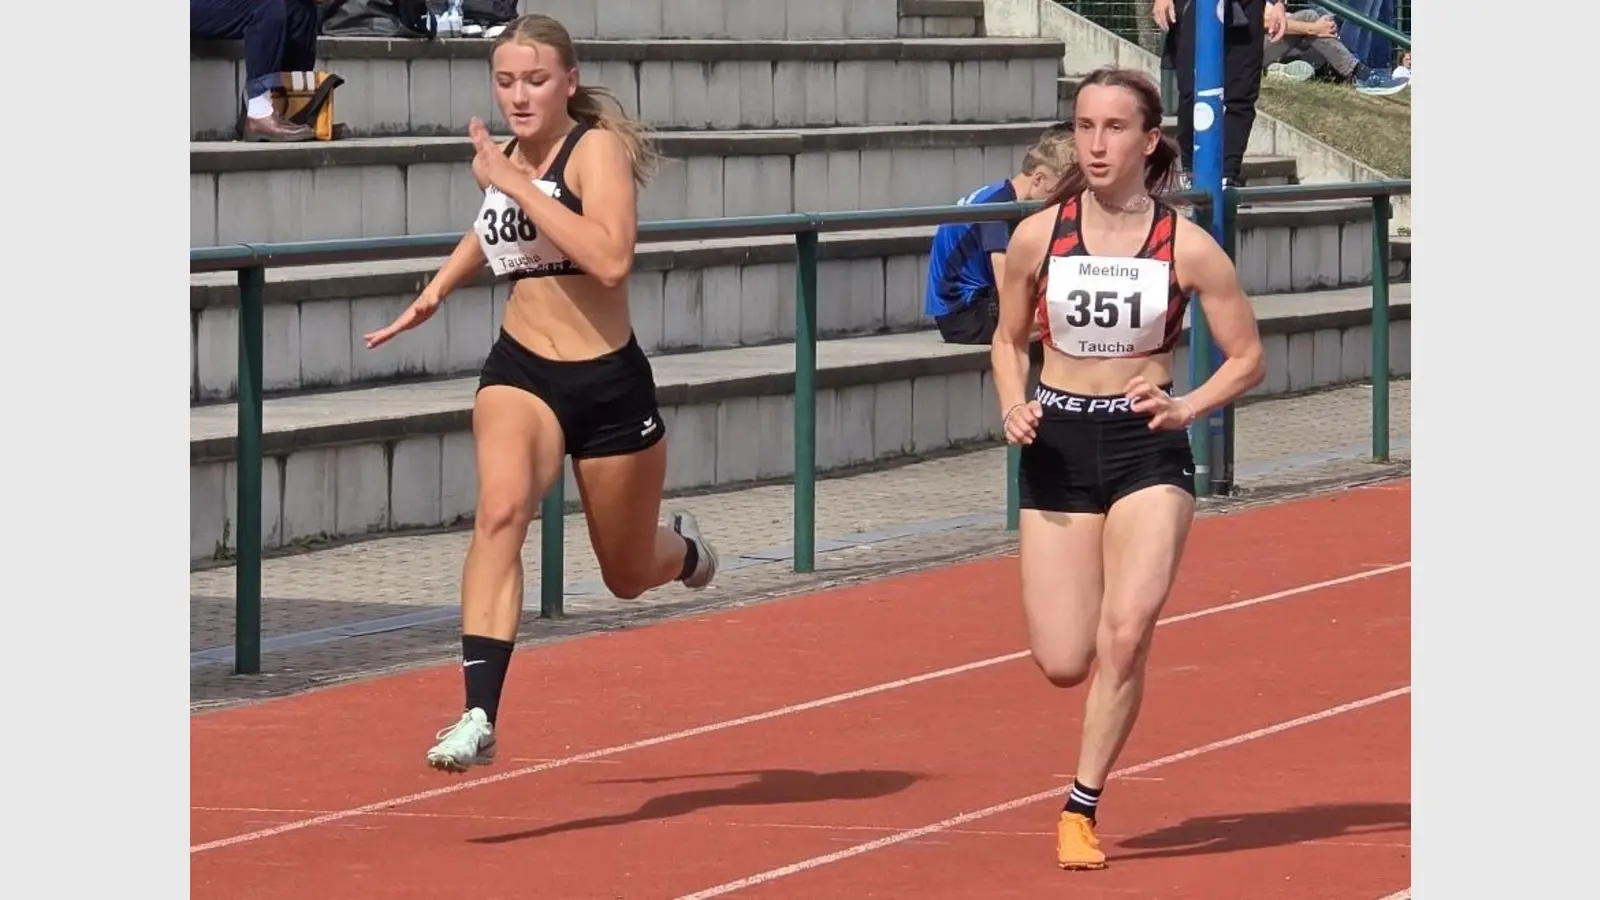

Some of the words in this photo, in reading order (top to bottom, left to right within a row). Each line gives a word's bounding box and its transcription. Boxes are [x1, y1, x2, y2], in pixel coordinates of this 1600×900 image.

[483, 207, 537, 246] 388
[1079, 263, 1139, 280] Meeting
[1066, 289, 1142, 329] 351
[1078, 340, 1134, 353] Taucha
[1034, 385, 1086, 413] NIKE
